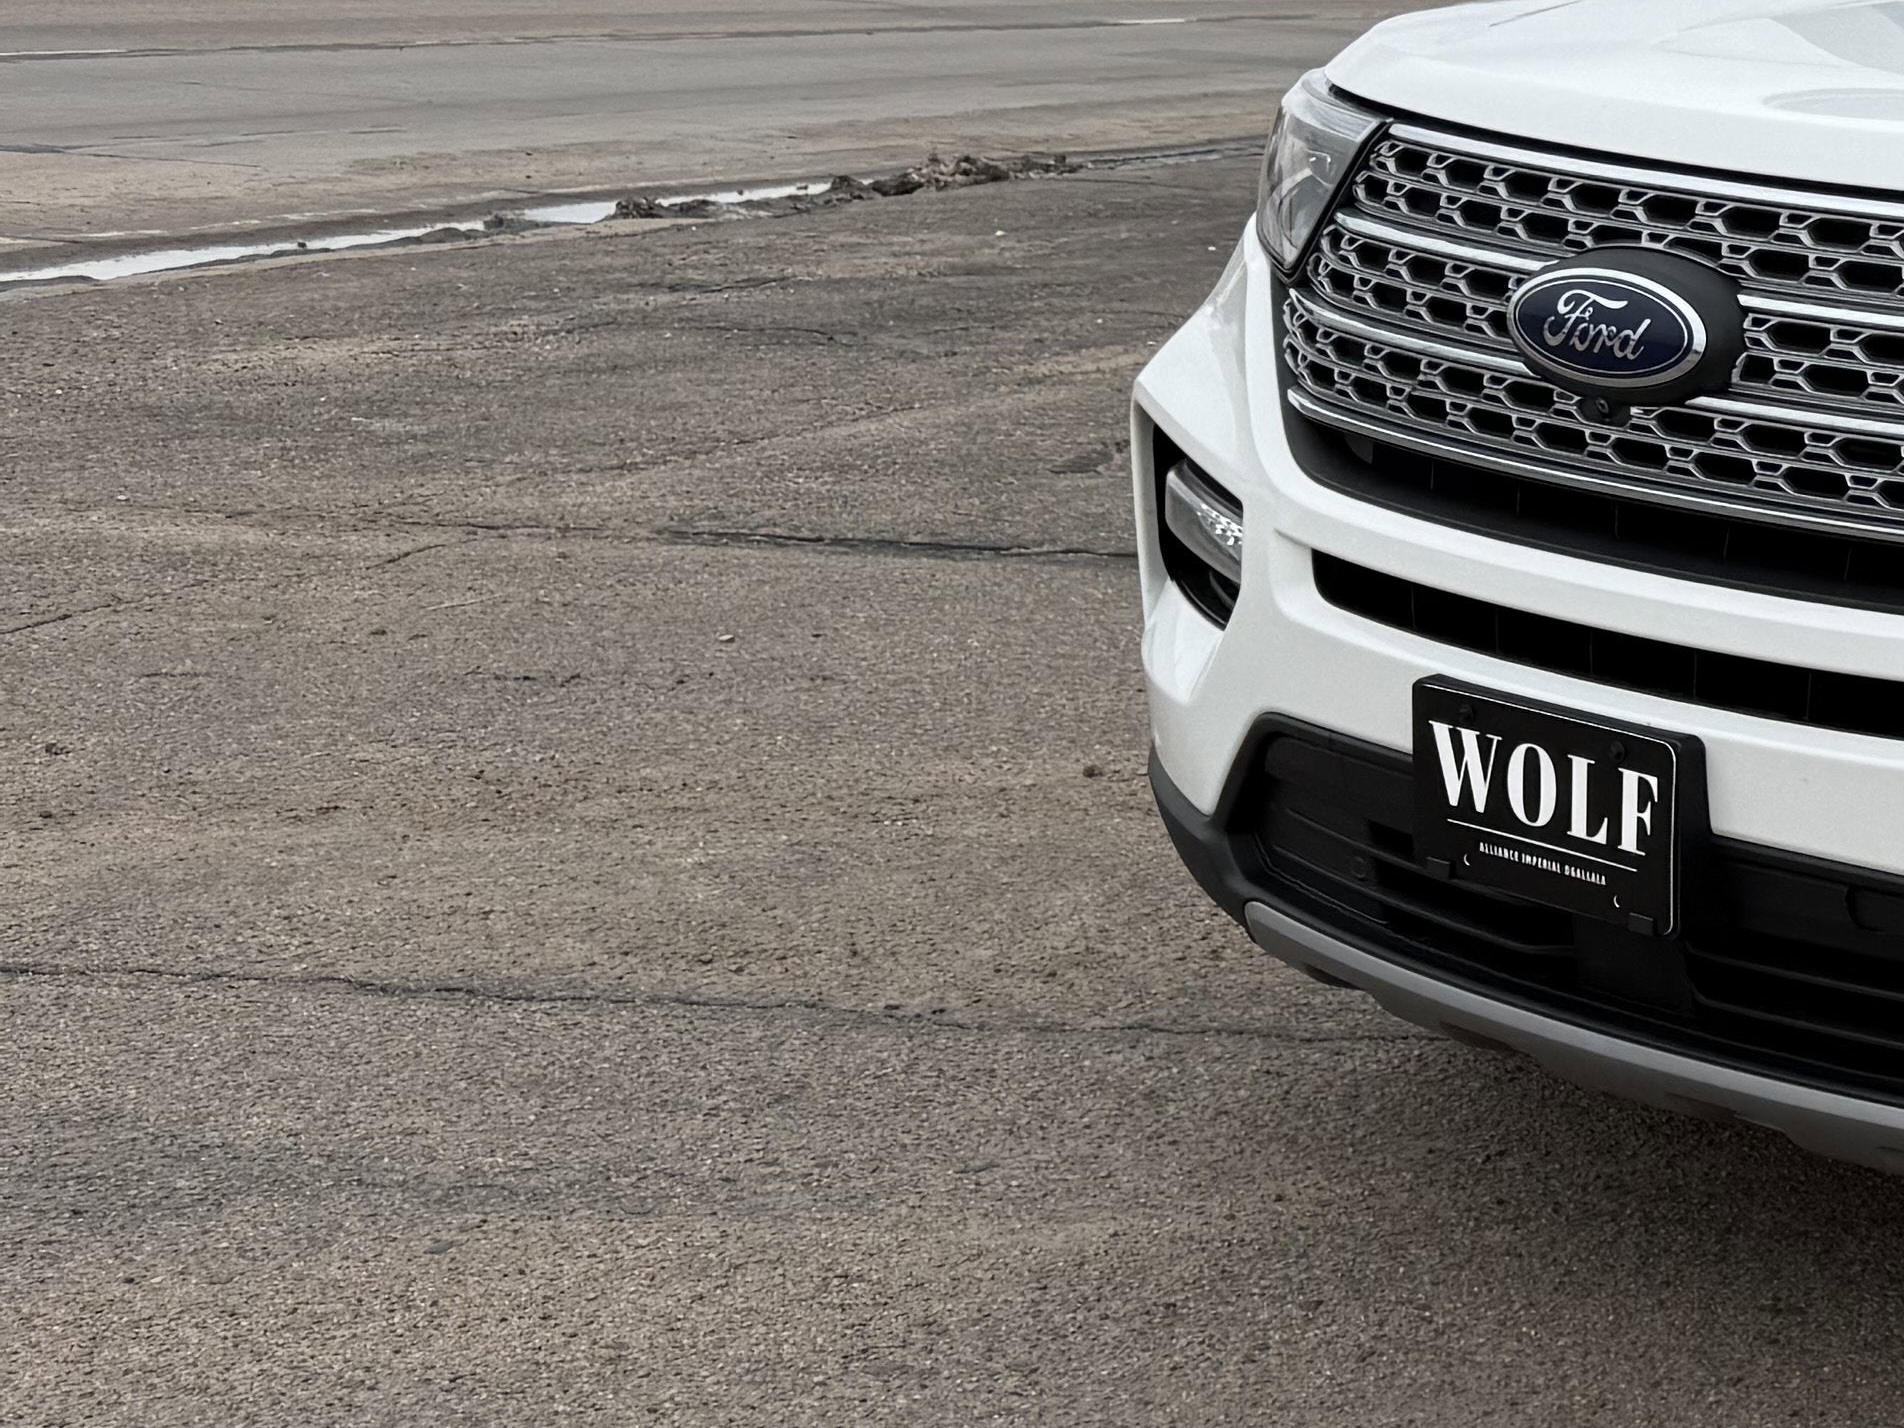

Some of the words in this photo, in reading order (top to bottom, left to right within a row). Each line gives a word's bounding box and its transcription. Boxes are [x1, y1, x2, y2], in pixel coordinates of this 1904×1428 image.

[1543, 289, 1652, 361] Ford
[1428, 720, 1659, 856] WOLF
[1479, 841, 1519, 862] ALLIANCE
[1521, 852, 1562, 874] IMPERIAL
[1564, 864, 1607, 886] OGALLALA
